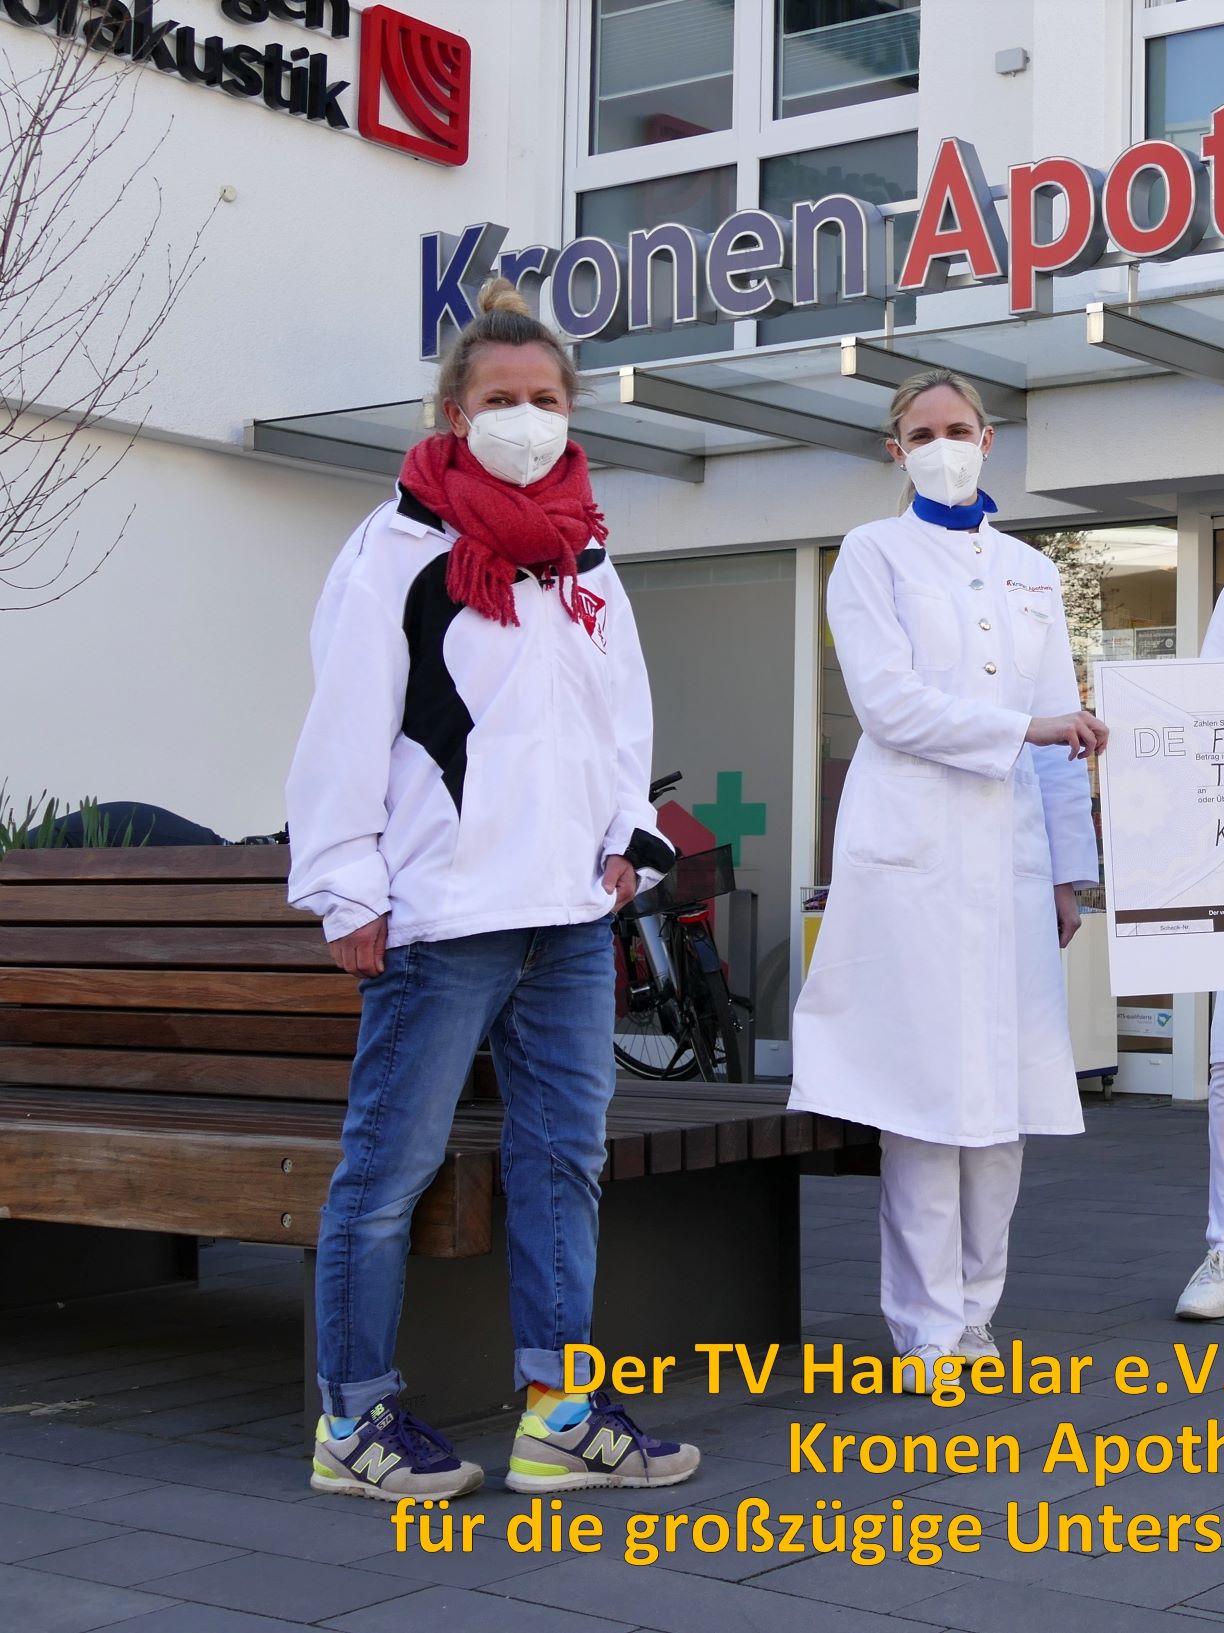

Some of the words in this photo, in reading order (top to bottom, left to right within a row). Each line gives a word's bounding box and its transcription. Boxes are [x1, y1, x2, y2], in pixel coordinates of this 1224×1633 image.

[419, 192, 880, 362] Kronen
[1193, 720, 1218, 728] Zahlen
[1133, 726, 1186, 759] DE
[1195, 753, 1220, 761] Betrag
[352, 1441, 402, 1484] N
[582, 1427, 633, 1467] N
